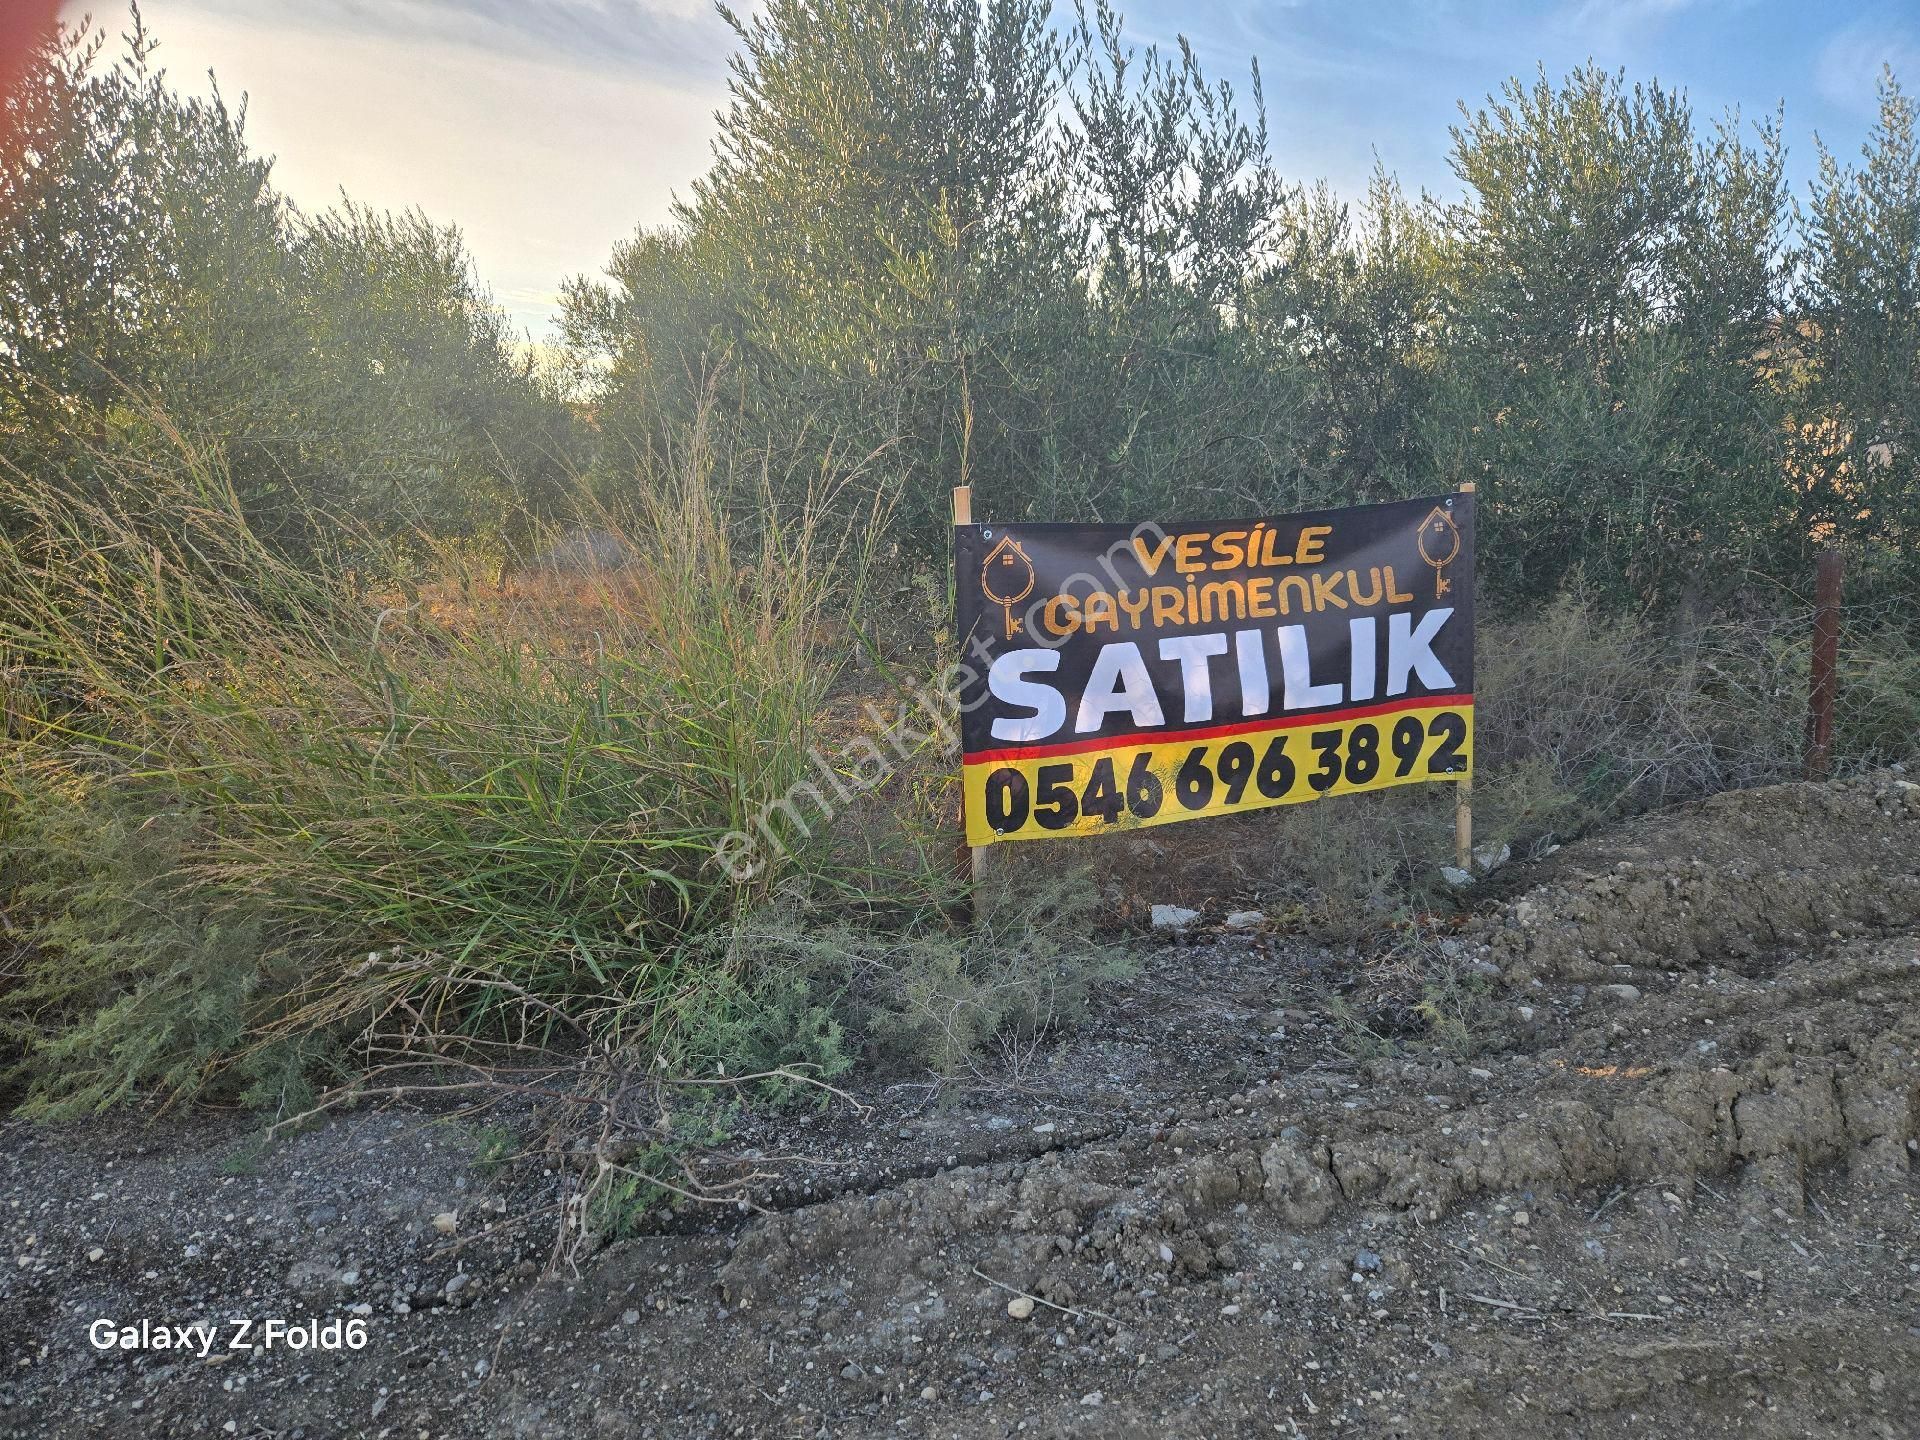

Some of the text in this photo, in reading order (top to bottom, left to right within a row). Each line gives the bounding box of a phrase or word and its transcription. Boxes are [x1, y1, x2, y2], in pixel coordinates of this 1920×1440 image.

[1133, 522, 1333, 577] VESİLE
[1043, 565, 1414, 636] GAYRİMENKUL
[987, 607, 1456, 742] SATILIK
[985, 711, 1468, 834] 0546 696 38 92
